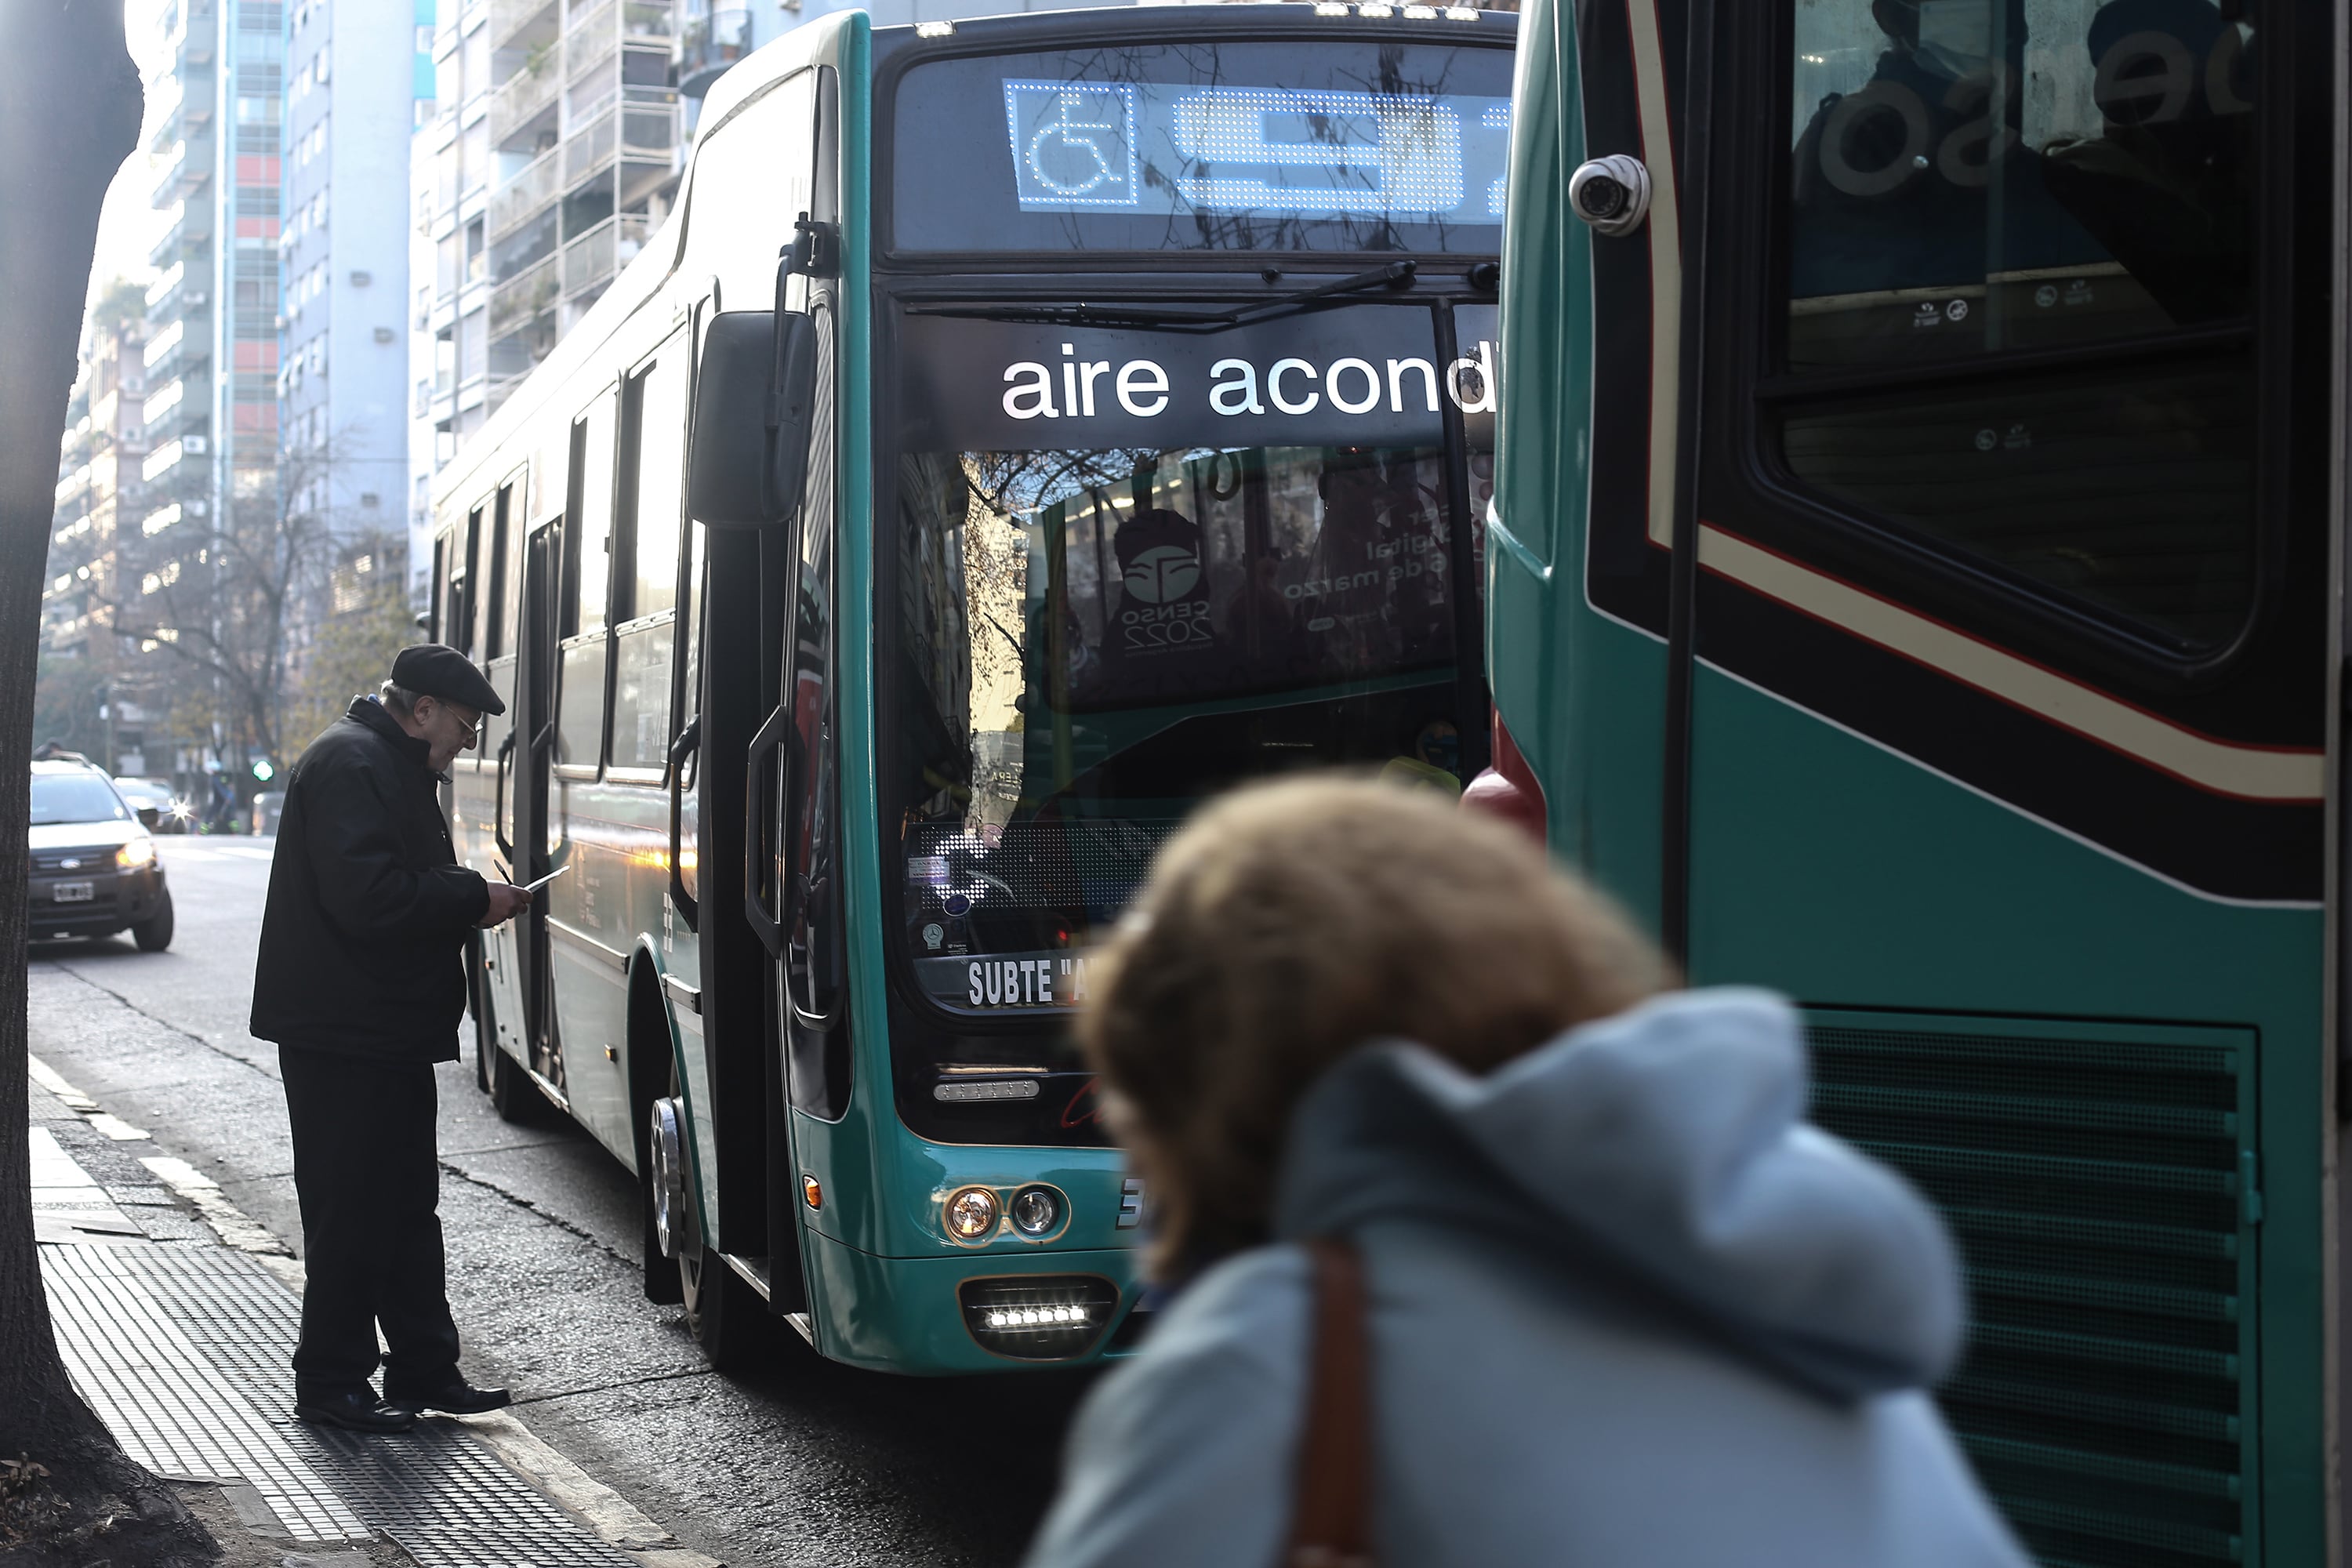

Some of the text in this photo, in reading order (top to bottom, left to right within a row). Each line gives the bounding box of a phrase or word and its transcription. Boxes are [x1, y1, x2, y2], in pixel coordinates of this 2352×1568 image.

[1001, 339, 1501, 419] aire acond
[968, 959, 1053, 1006] SUBTE
